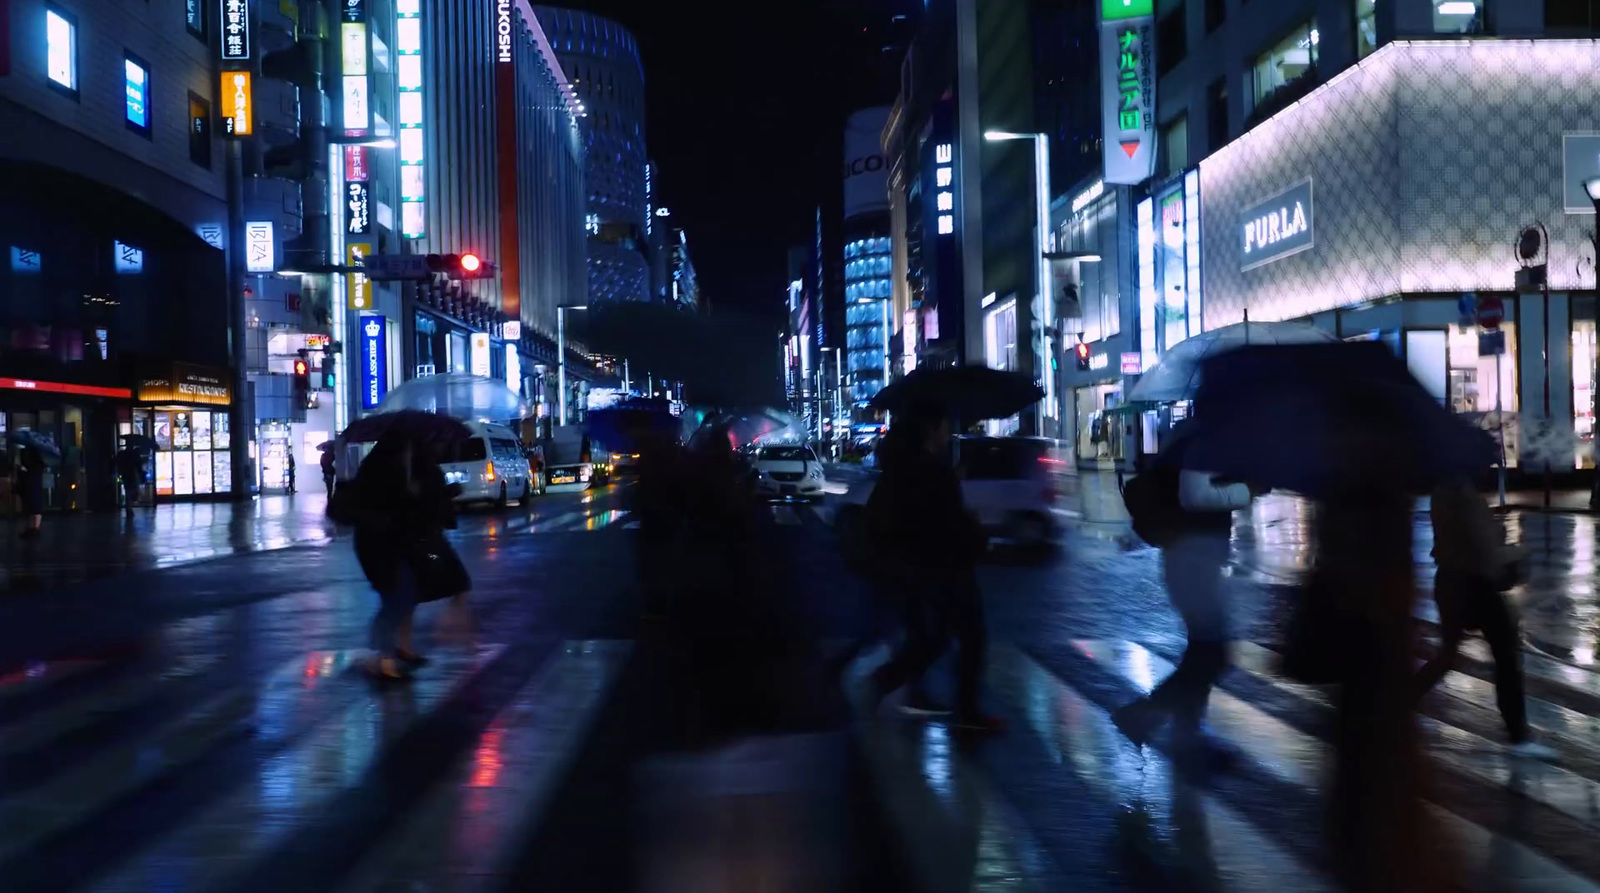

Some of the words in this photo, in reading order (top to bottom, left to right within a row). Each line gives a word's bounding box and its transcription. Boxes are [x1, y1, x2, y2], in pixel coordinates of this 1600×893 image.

[498, 0, 511, 62] UKOSHI
[1119, 29, 1140, 130] ナルニア国
[1244, 201, 1307, 253] FURLA
